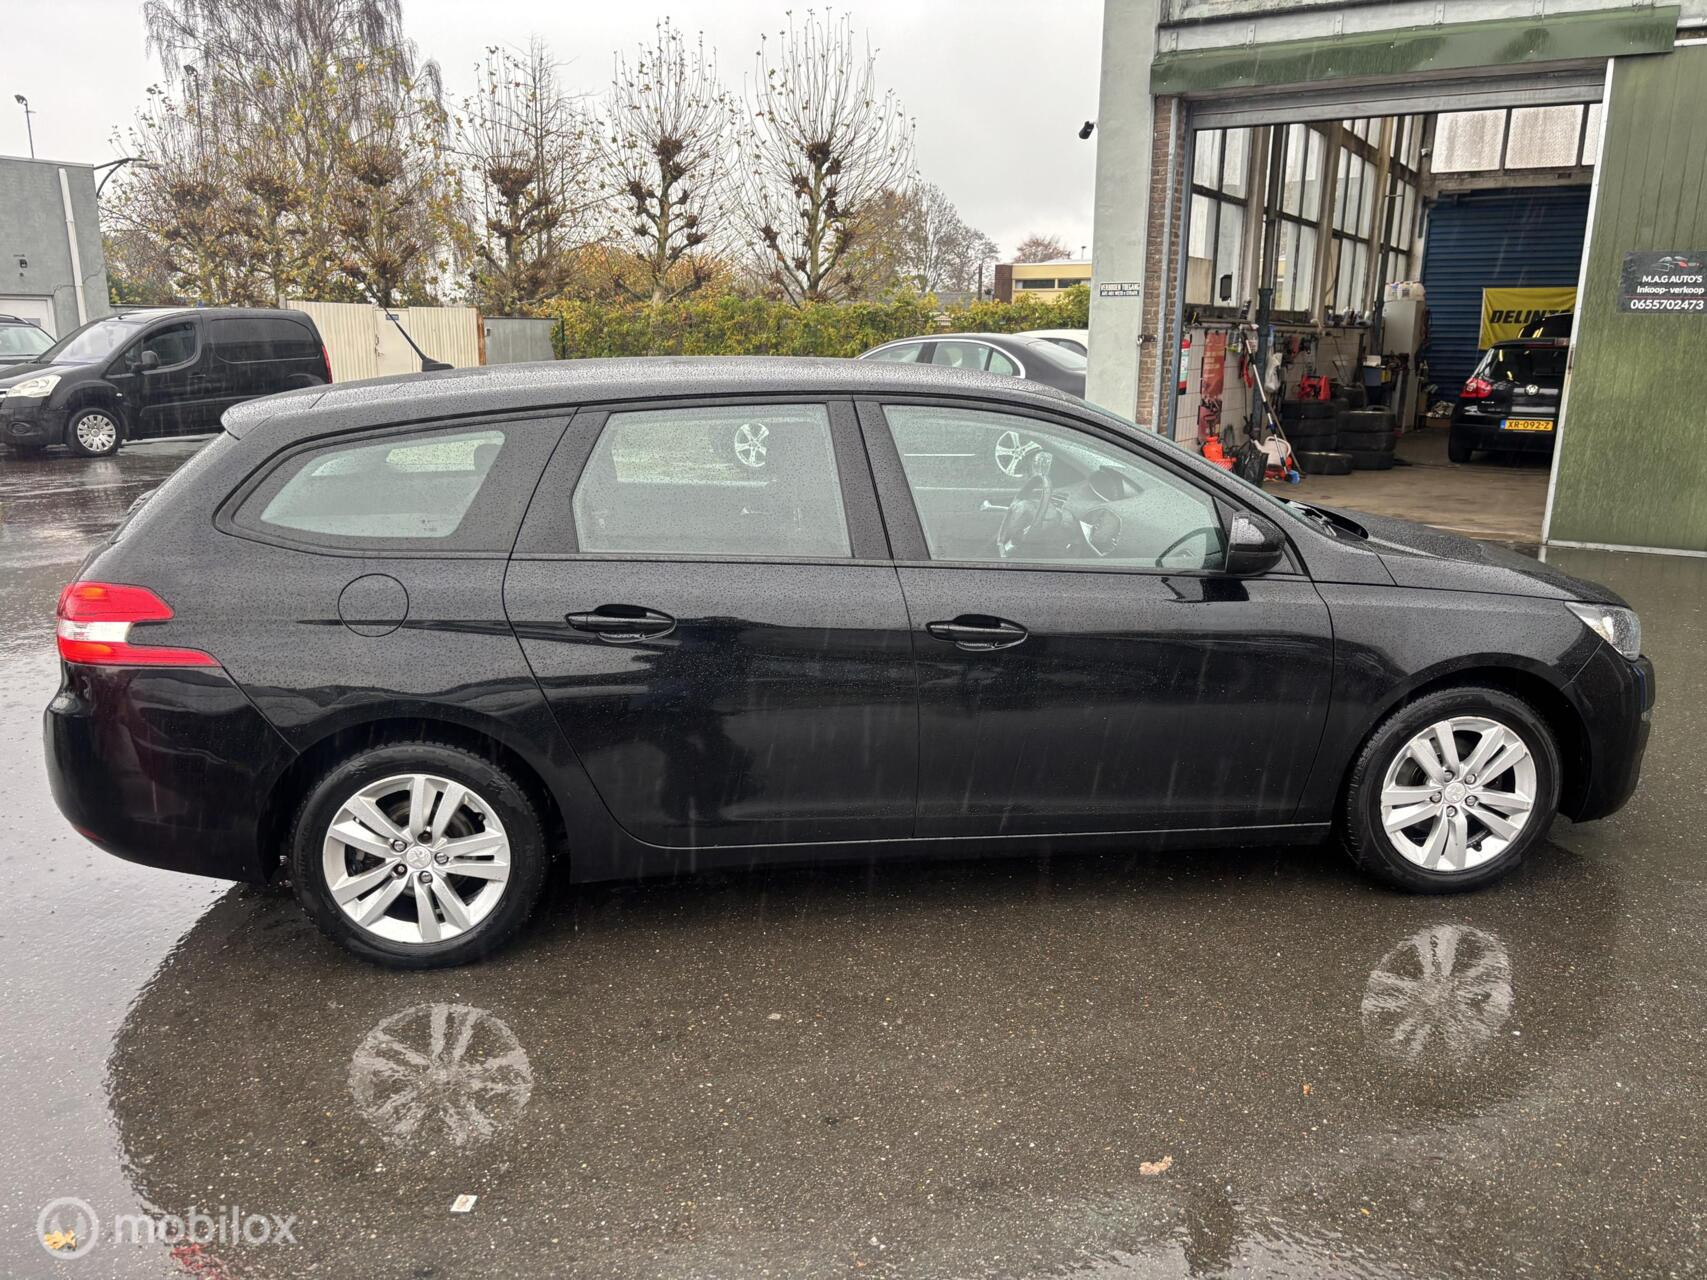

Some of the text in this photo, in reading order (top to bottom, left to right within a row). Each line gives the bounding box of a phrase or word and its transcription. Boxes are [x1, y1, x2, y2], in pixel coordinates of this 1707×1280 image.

[1642, 275, 1703, 283] M.A.G AUTO'S
[1670, 286, 1705, 294] verkoop
[1630, 300, 1704, 310] 0655702473
[1490, 309, 1571, 324] DELIN
[1508, 421, 1550, 430] XR-092-Z
